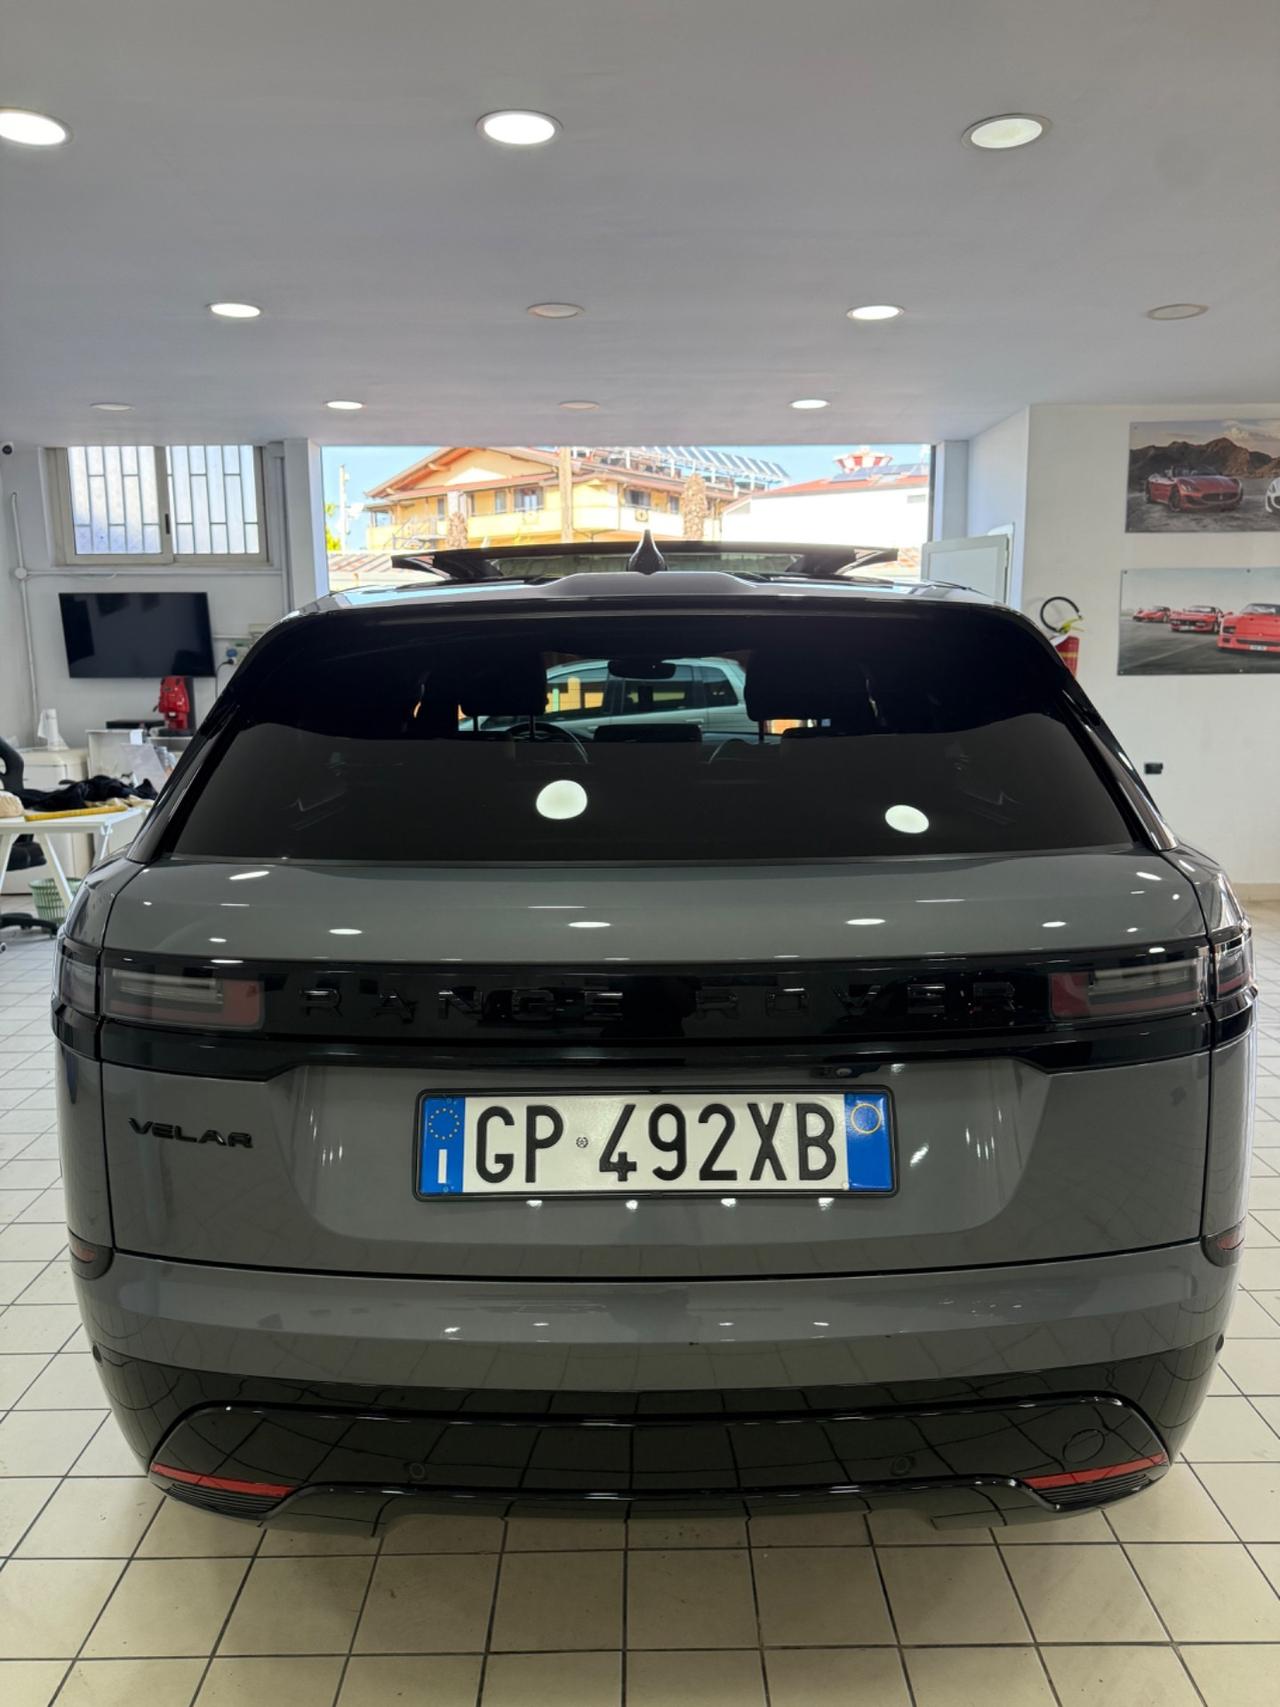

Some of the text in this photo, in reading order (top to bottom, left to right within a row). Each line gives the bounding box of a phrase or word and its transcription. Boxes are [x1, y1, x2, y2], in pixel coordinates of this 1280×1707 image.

[300, 988, 625, 1023] RANGE
[127, 1117, 254, 1149] VELAR
[475, 1104, 565, 1184] GP
[598, 1101, 837, 1183] 492XB
